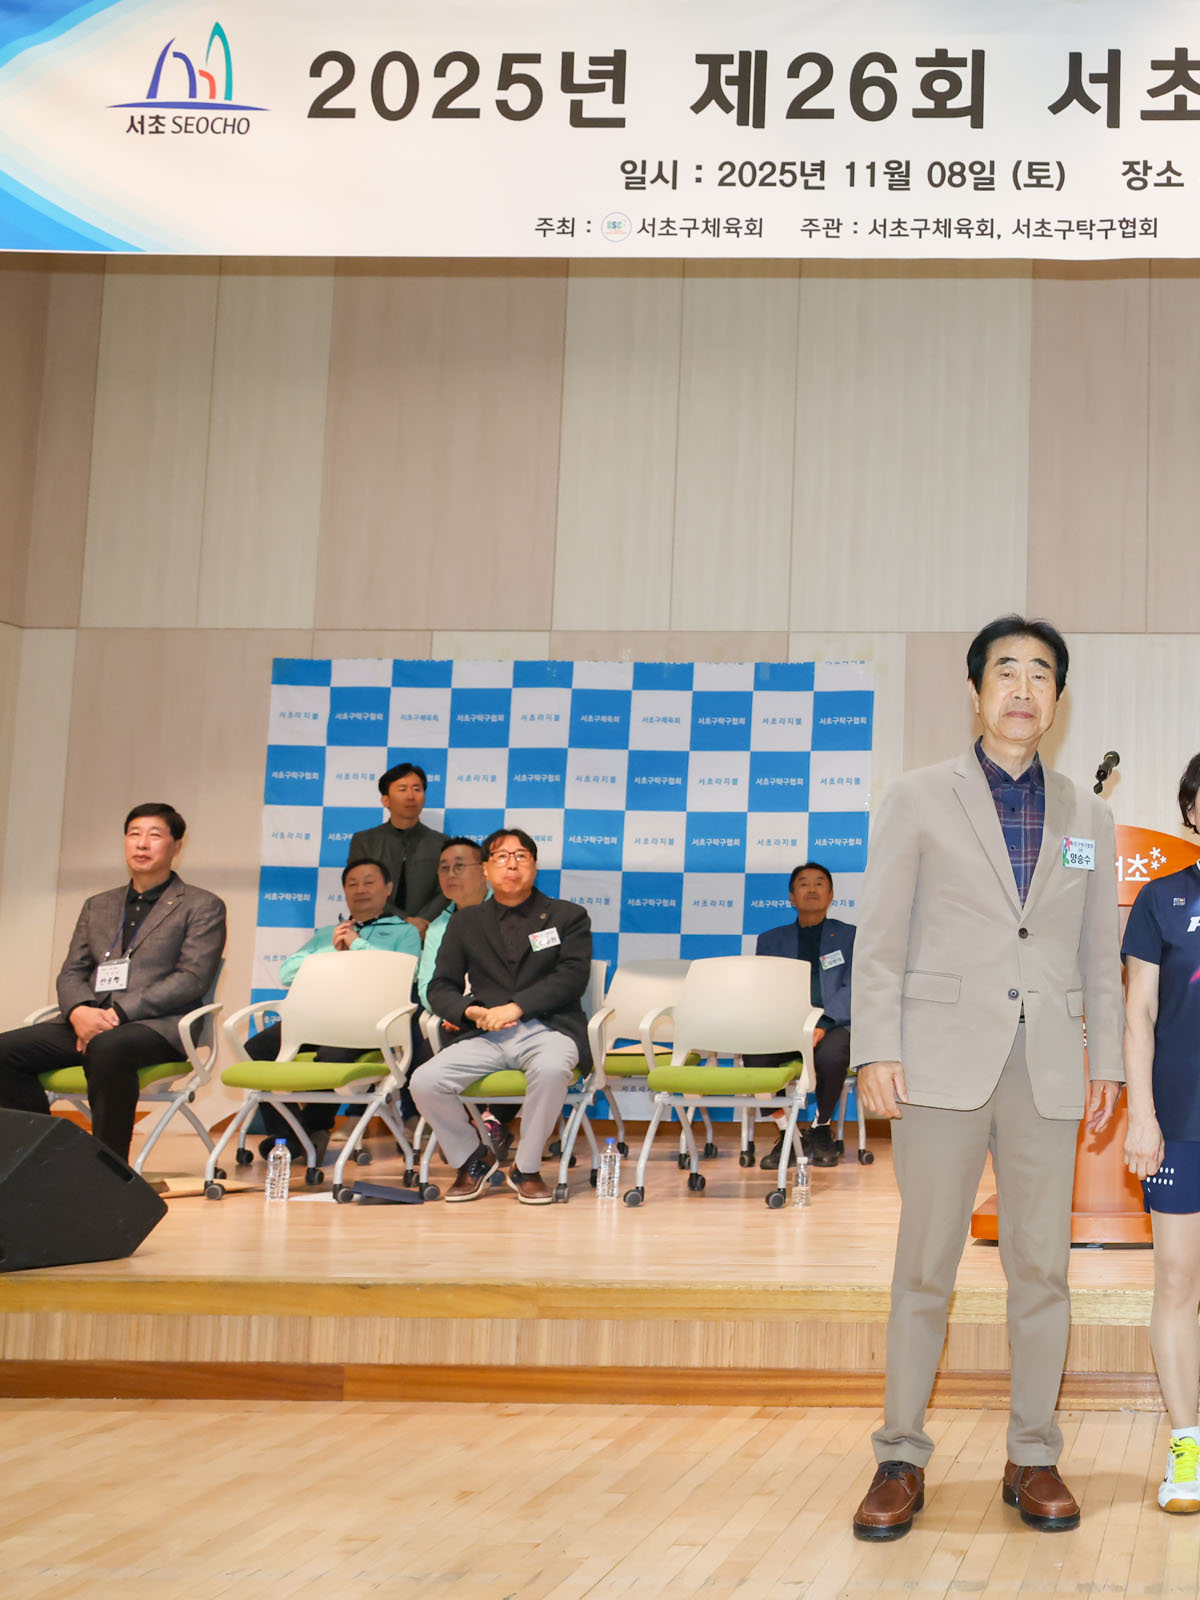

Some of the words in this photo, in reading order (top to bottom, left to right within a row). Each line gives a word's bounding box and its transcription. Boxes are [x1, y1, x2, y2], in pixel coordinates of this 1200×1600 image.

[307, 49, 626, 128] 2025년
[690, 48, 985, 129] 제26회
[126, 115, 165, 135] 서초
[172, 116, 251, 135] SEOCHO
[620, 160, 677, 190] 일시
[718, 160, 825, 190] 2025년
[846, 160, 910, 191] 11월
[928, 160, 995, 191] 08일
[1012, 160, 1066, 191] (토)
[1122, 160, 1184, 191] 장소
[535, 217, 575, 238] 주최
[637, 217, 763, 238] 서초구체육회
[800, 217, 843, 238] 주관
[868, 217, 1001, 240] 서초구체육회,
[1012, 218, 1158, 240] 서초구탁구협회
[1070, 853, 1091, 865] 양승수
